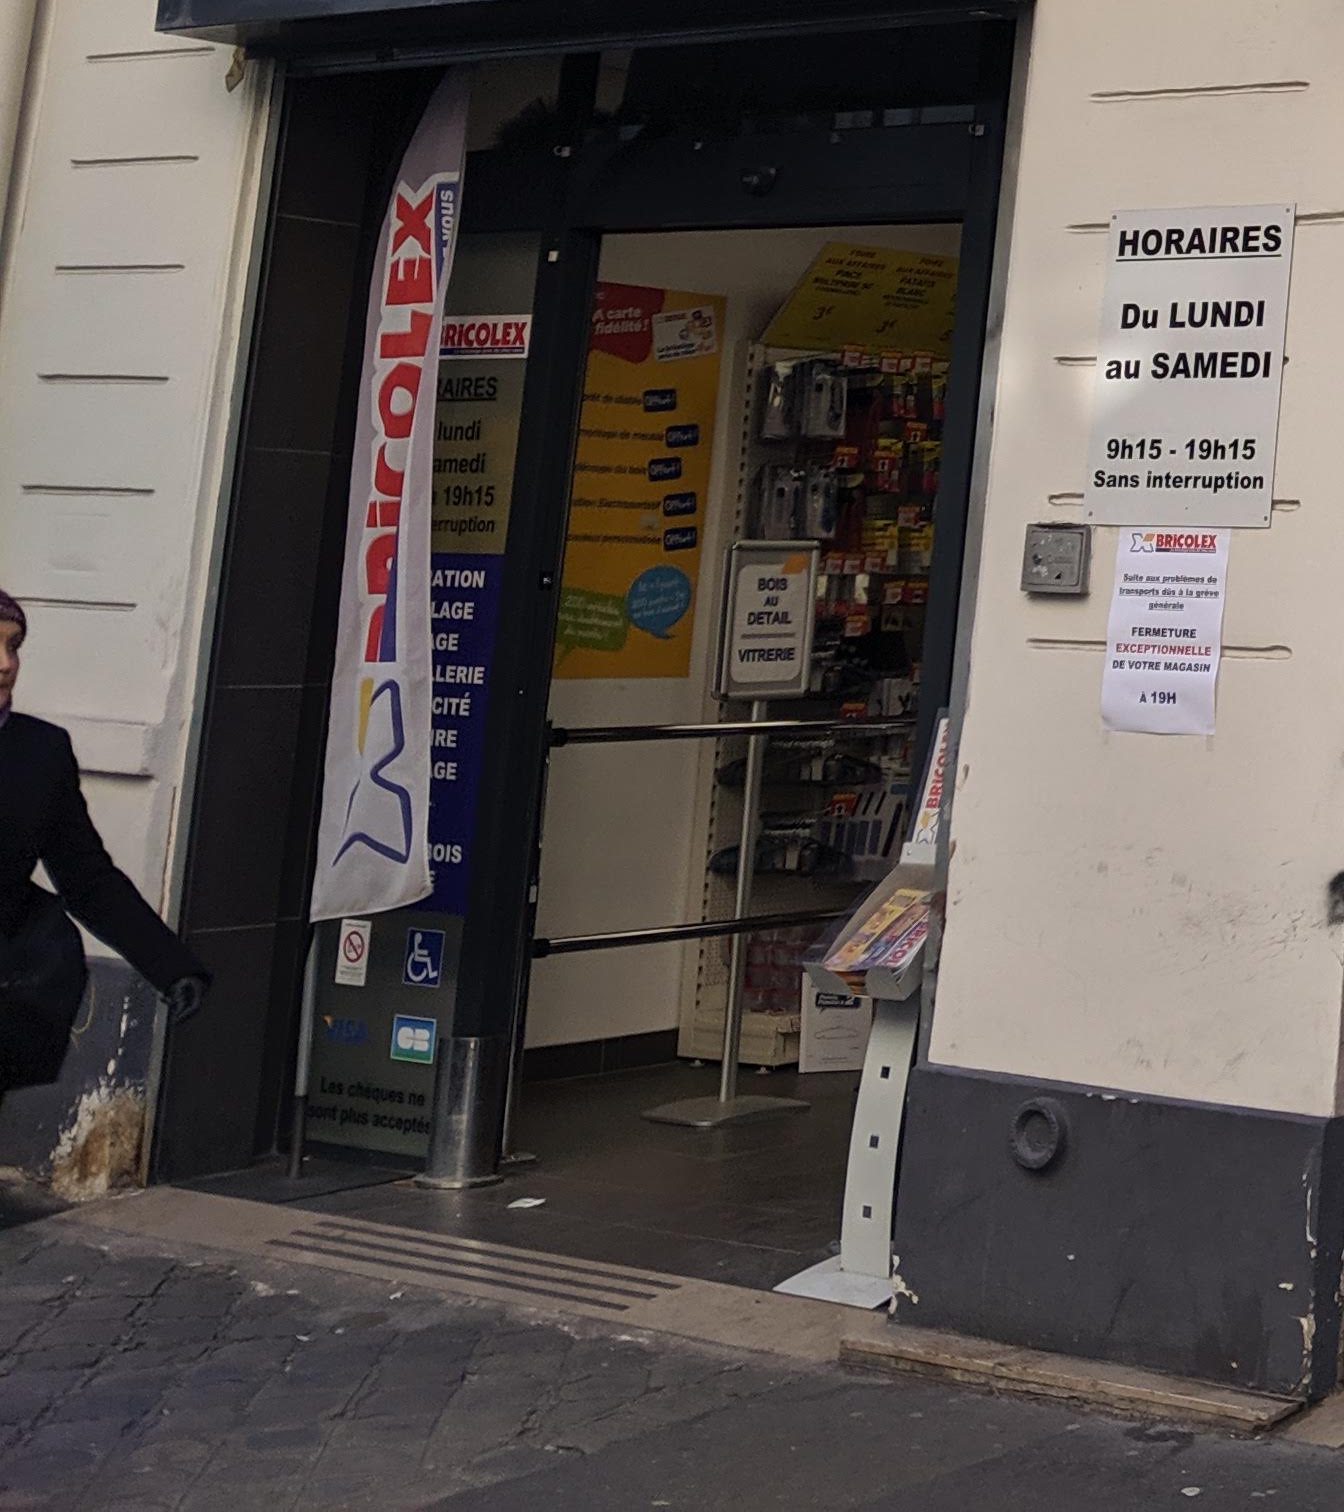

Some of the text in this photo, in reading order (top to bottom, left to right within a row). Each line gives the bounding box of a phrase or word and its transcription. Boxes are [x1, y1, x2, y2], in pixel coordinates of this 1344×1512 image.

[1117, 225, 1282, 257] HORAIRES
[1120, 301, 1265, 329] Du LUNDI
[1105, 352, 1271, 379] au SAMEDI
[1106, 439, 1256, 460] 9h15 19h15
[1093, 470, 1264, 493] Sans interruption
[443, 486, 494, 506] 19h15
[758, 578, 788, 591] BOIS
[1123, 573, 1143, 582] Suite
[1207, 576, 1217, 584] de
[1119, 587, 1159, 597] transports
[763, 596, 779, 607] AU
[747, 611, 792, 625] DETAIL
[1131, 627, 1197, 638] FERMETURE
[738, 648, 795, 662] VITRERIE
[1115, 643, 1212, 656] EXCEPTIONNELLE
[1112, 660, 1210, 672] DE VOTRE MAGASIN
[1151, 692, 1176, 704] 19H
[408, 1093, 425, 1106] ne
[340, 1108, 368, 1125] plus
